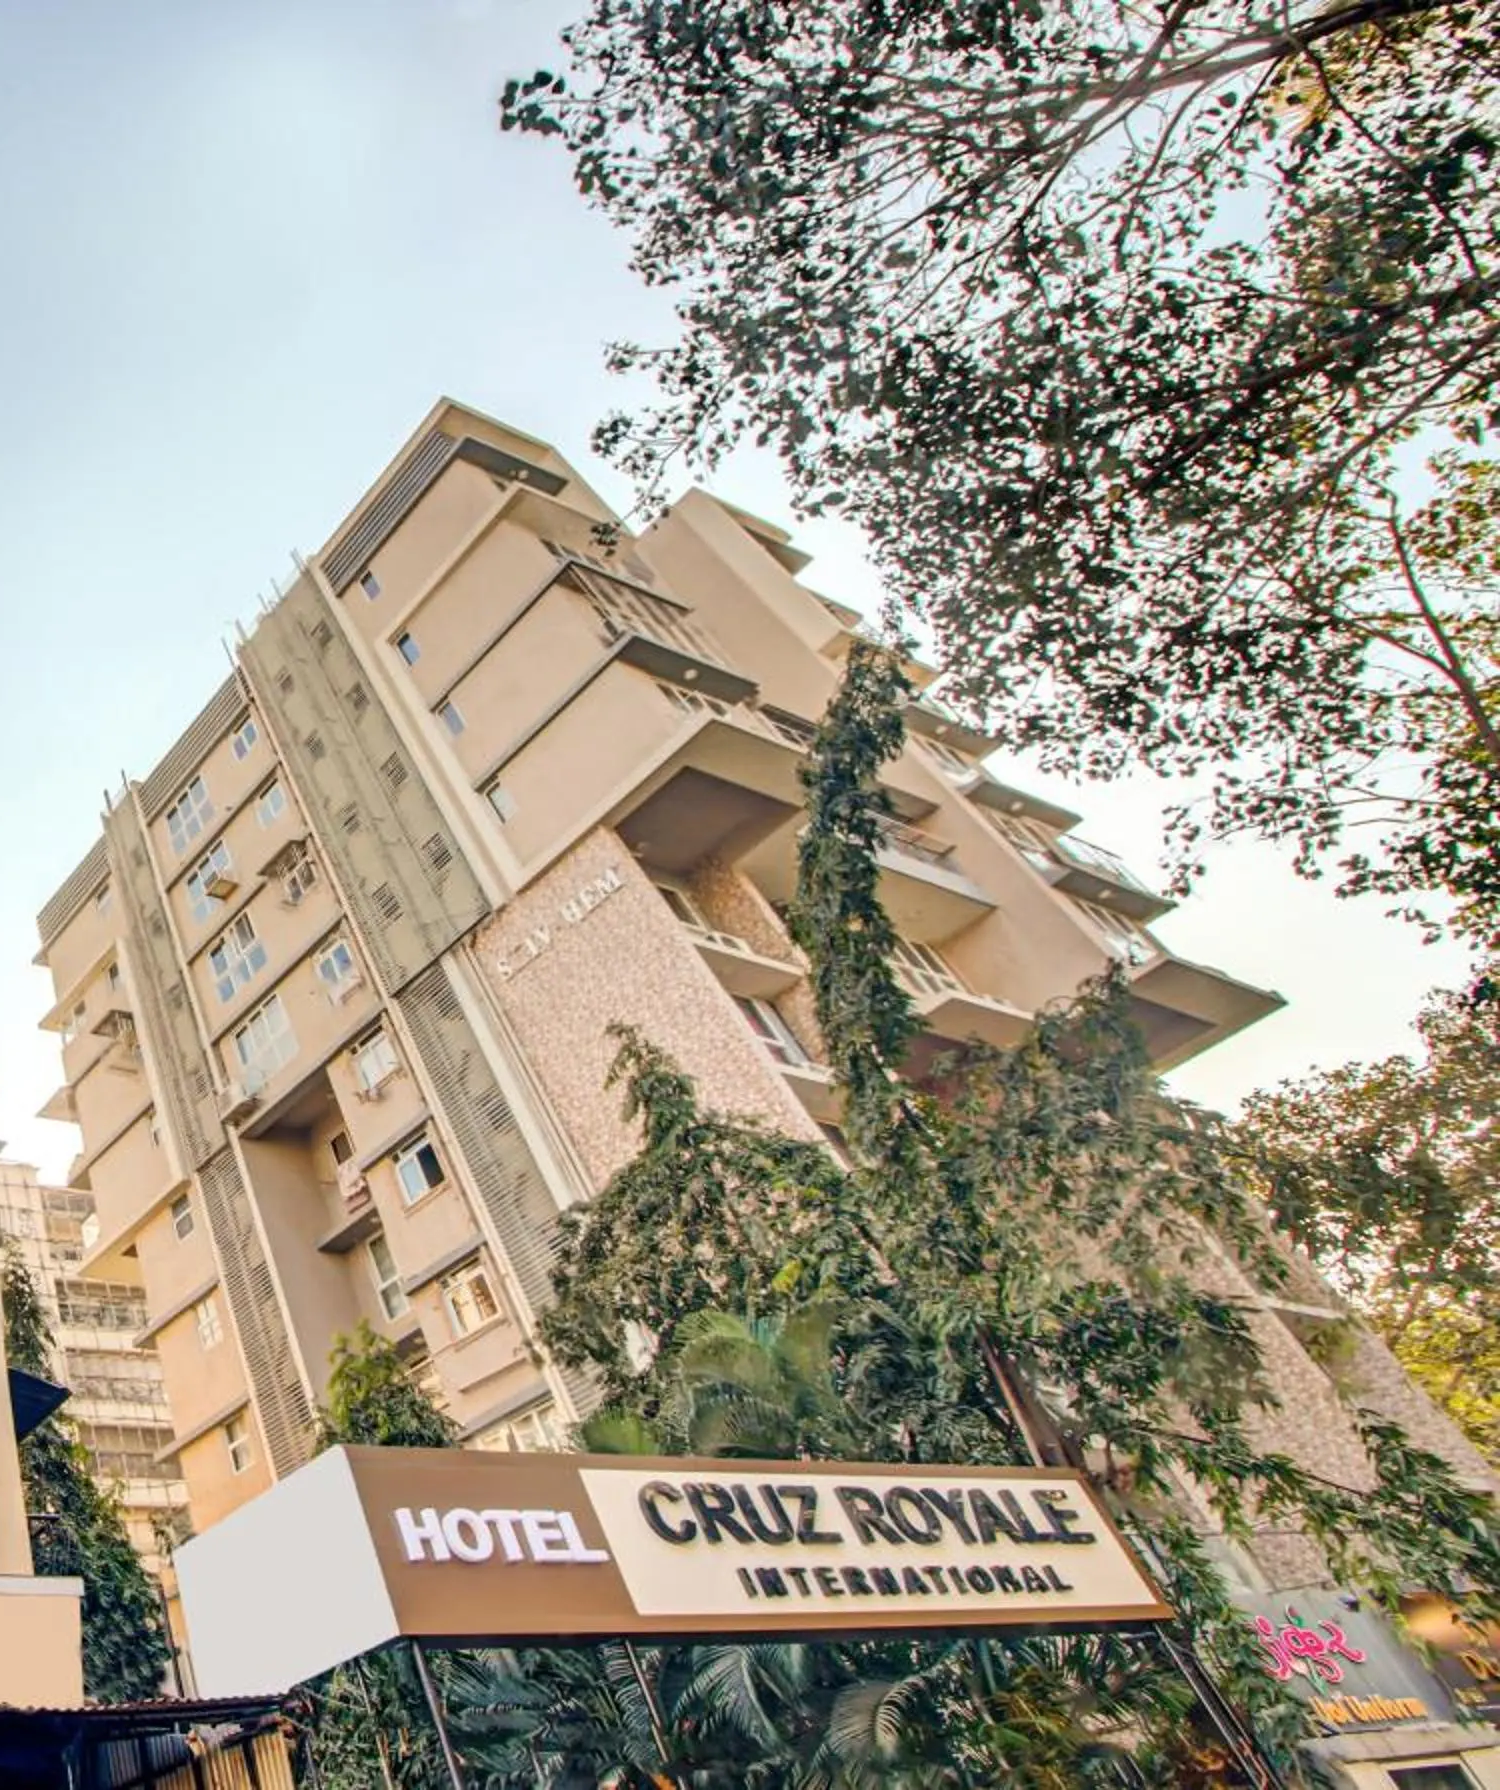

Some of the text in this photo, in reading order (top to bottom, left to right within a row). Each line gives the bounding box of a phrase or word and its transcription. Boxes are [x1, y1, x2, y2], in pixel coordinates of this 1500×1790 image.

[394, 1506, 609, 1564] HOTEL
[638, 1481, 1097, 1546] CRUZ ROYALE
[736, 1564, 1074, 1598] INTERNATIONAL
